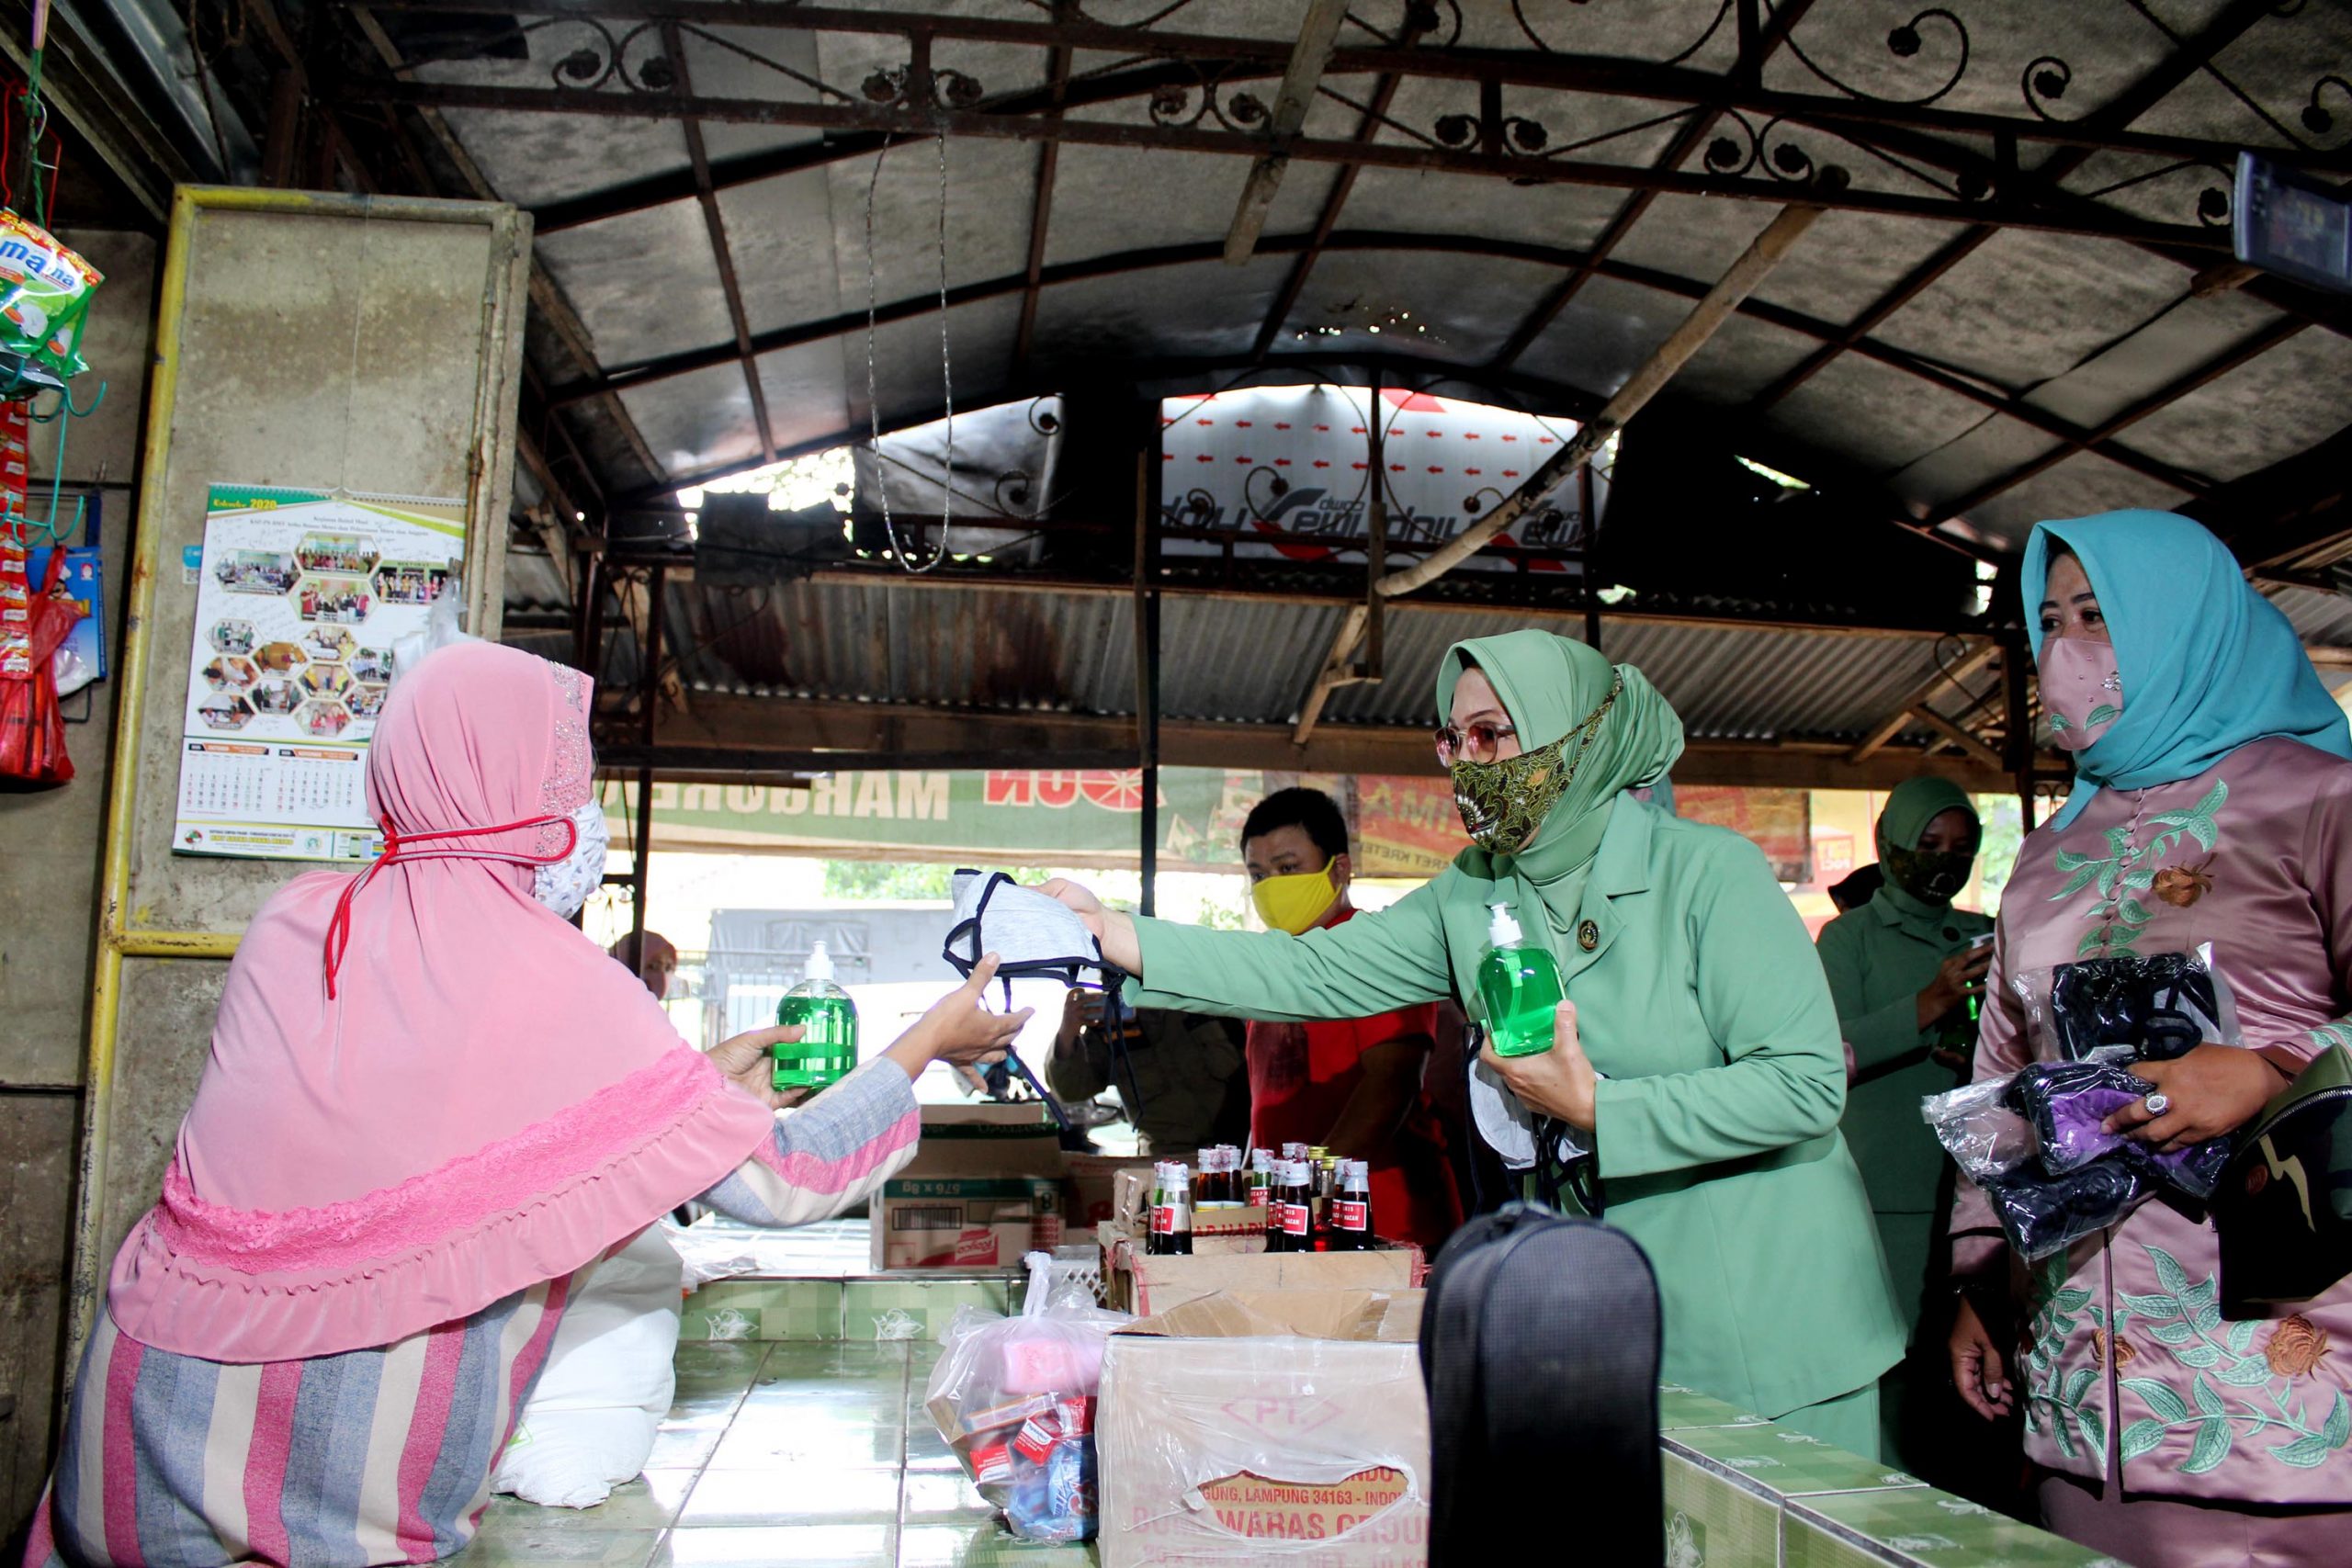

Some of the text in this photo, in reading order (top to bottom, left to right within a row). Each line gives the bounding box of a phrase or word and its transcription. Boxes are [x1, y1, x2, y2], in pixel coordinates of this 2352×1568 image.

[250, 498, 277, 510] 2020
[936, 1181, 960, 1194] 576
[1245, 1488, 1310, 1505] LAMPUNG
[1313, 1489, 1352, 1506] 34163
[1216, 1509, 1326, 1541] WARAS
